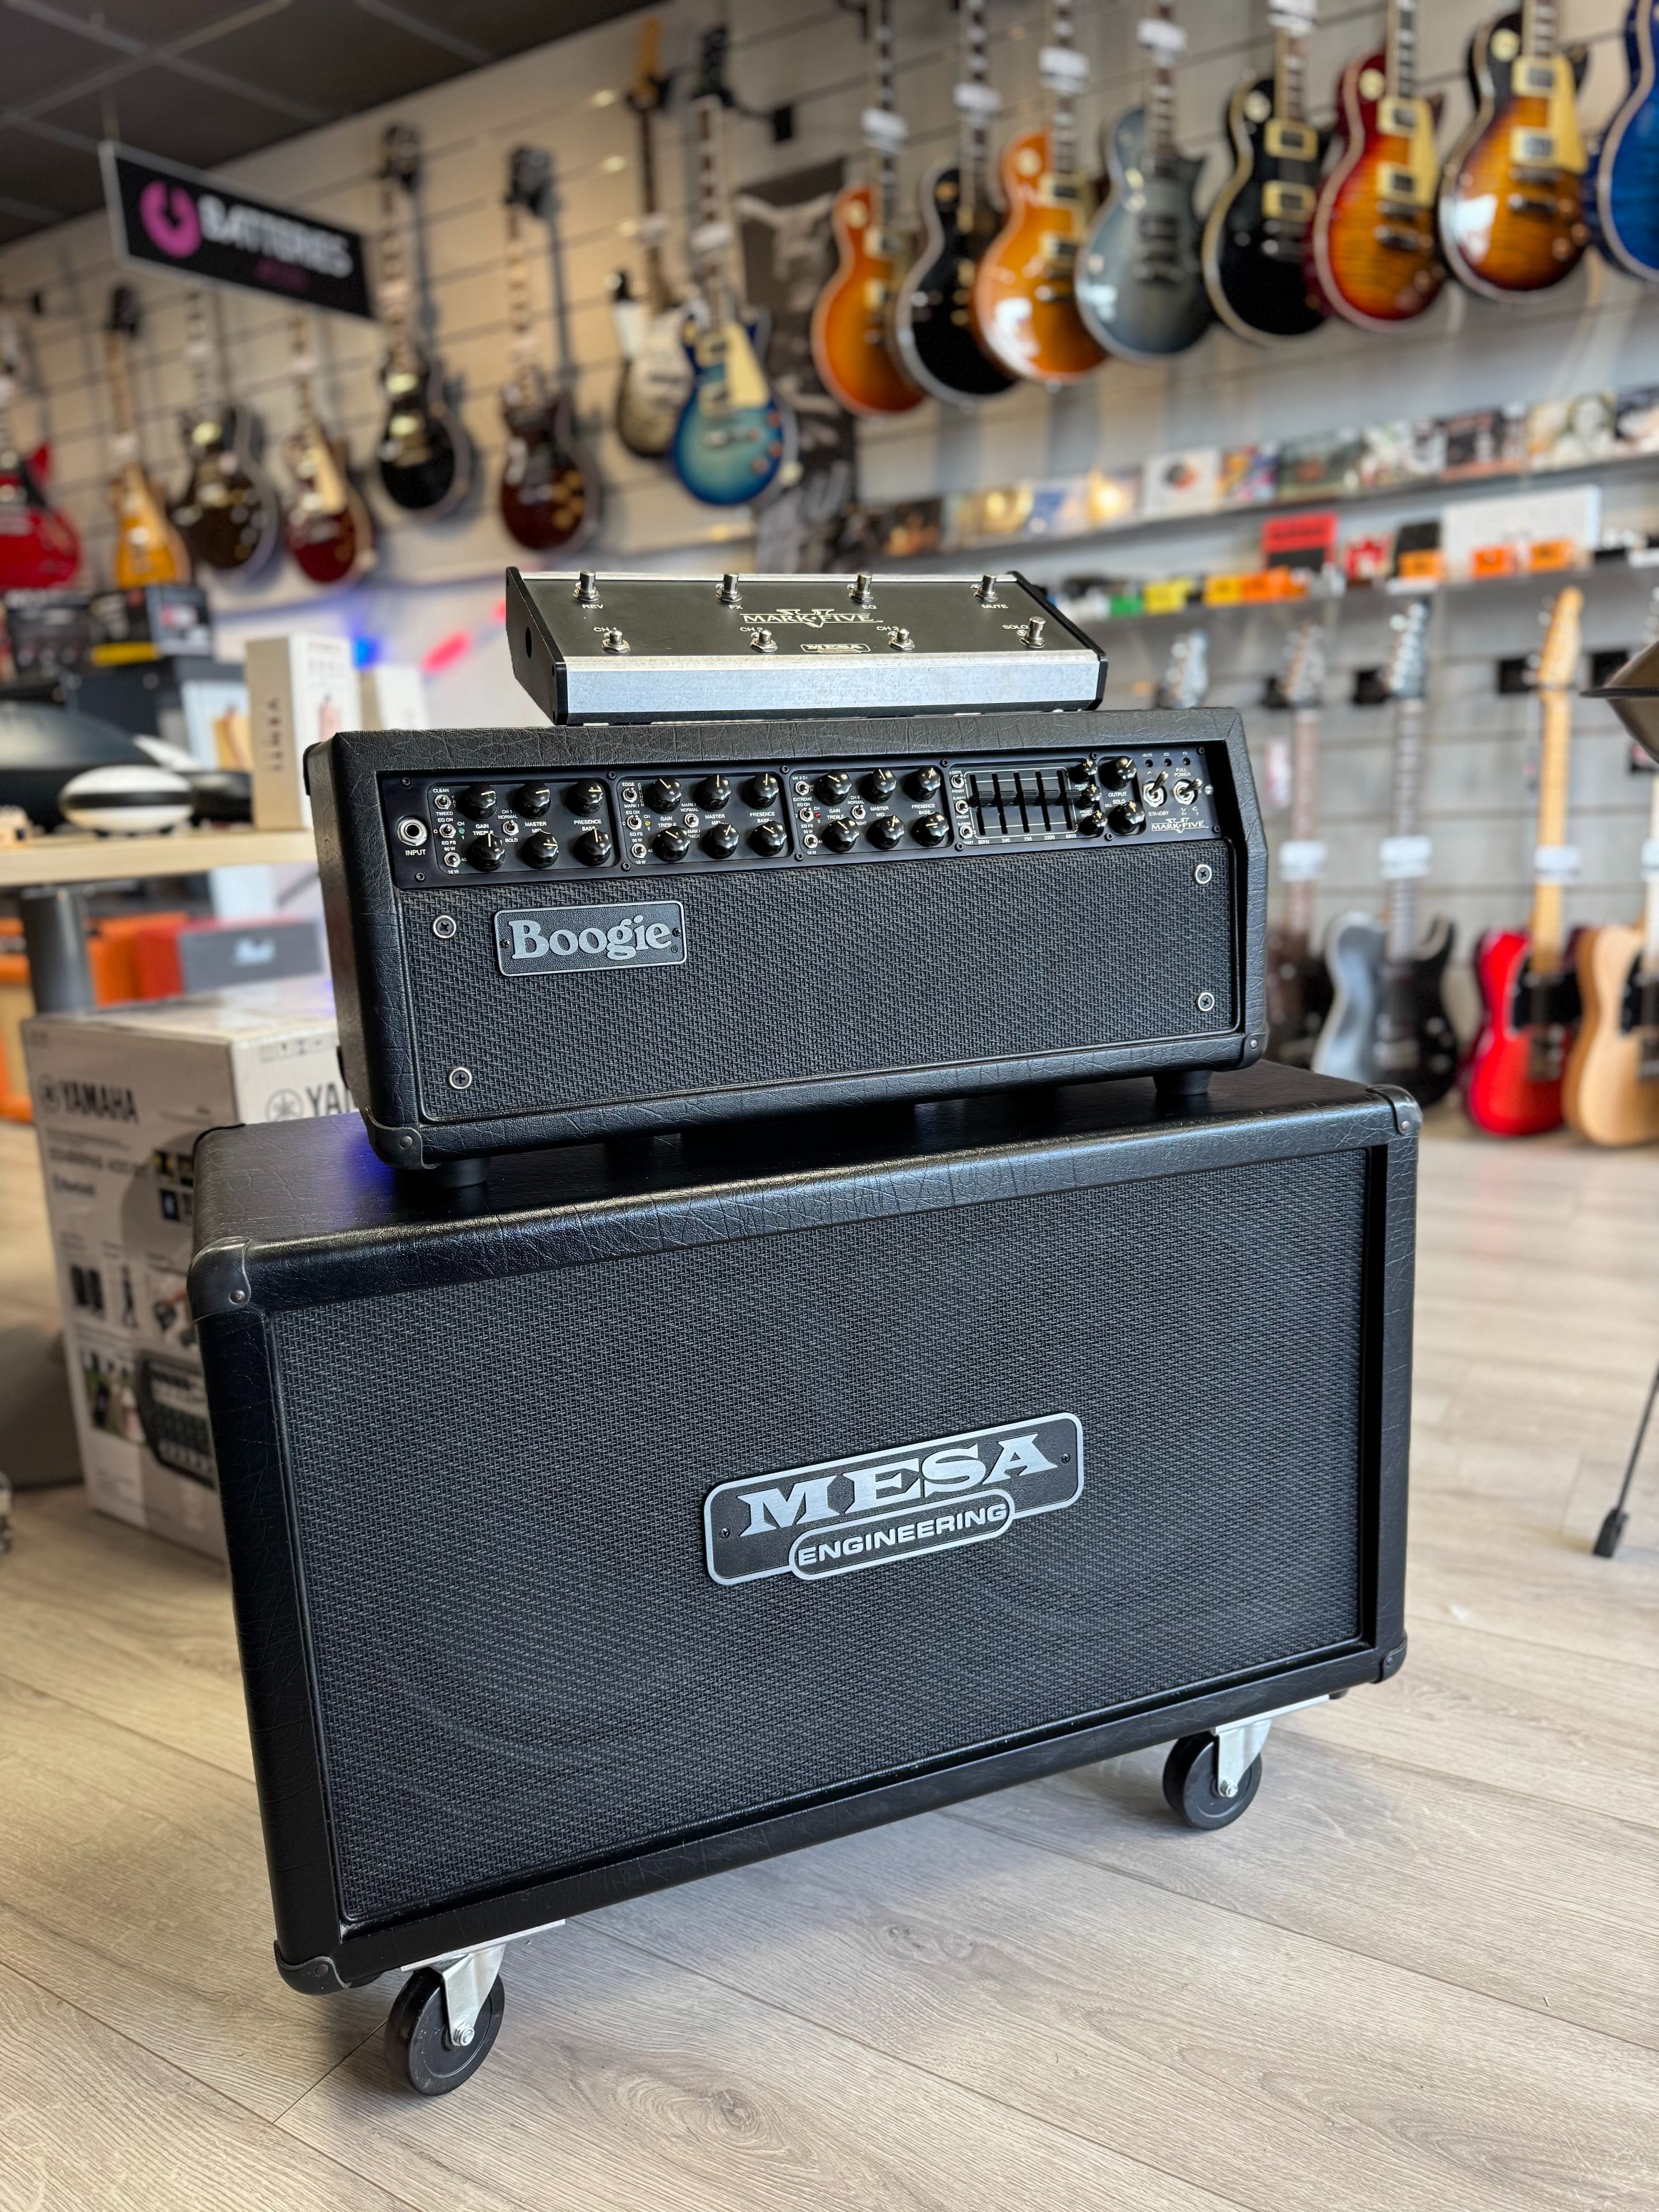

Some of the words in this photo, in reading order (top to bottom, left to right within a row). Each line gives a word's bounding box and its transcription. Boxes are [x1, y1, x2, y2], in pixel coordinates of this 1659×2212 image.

[508, 915, 672, 960] Boogie
[60, 1080, 139, 1125] YAMAHA
[737, 1433, 1058, 1537] MESA
[797, 1503, 1007, 1567] ENGINEERING
